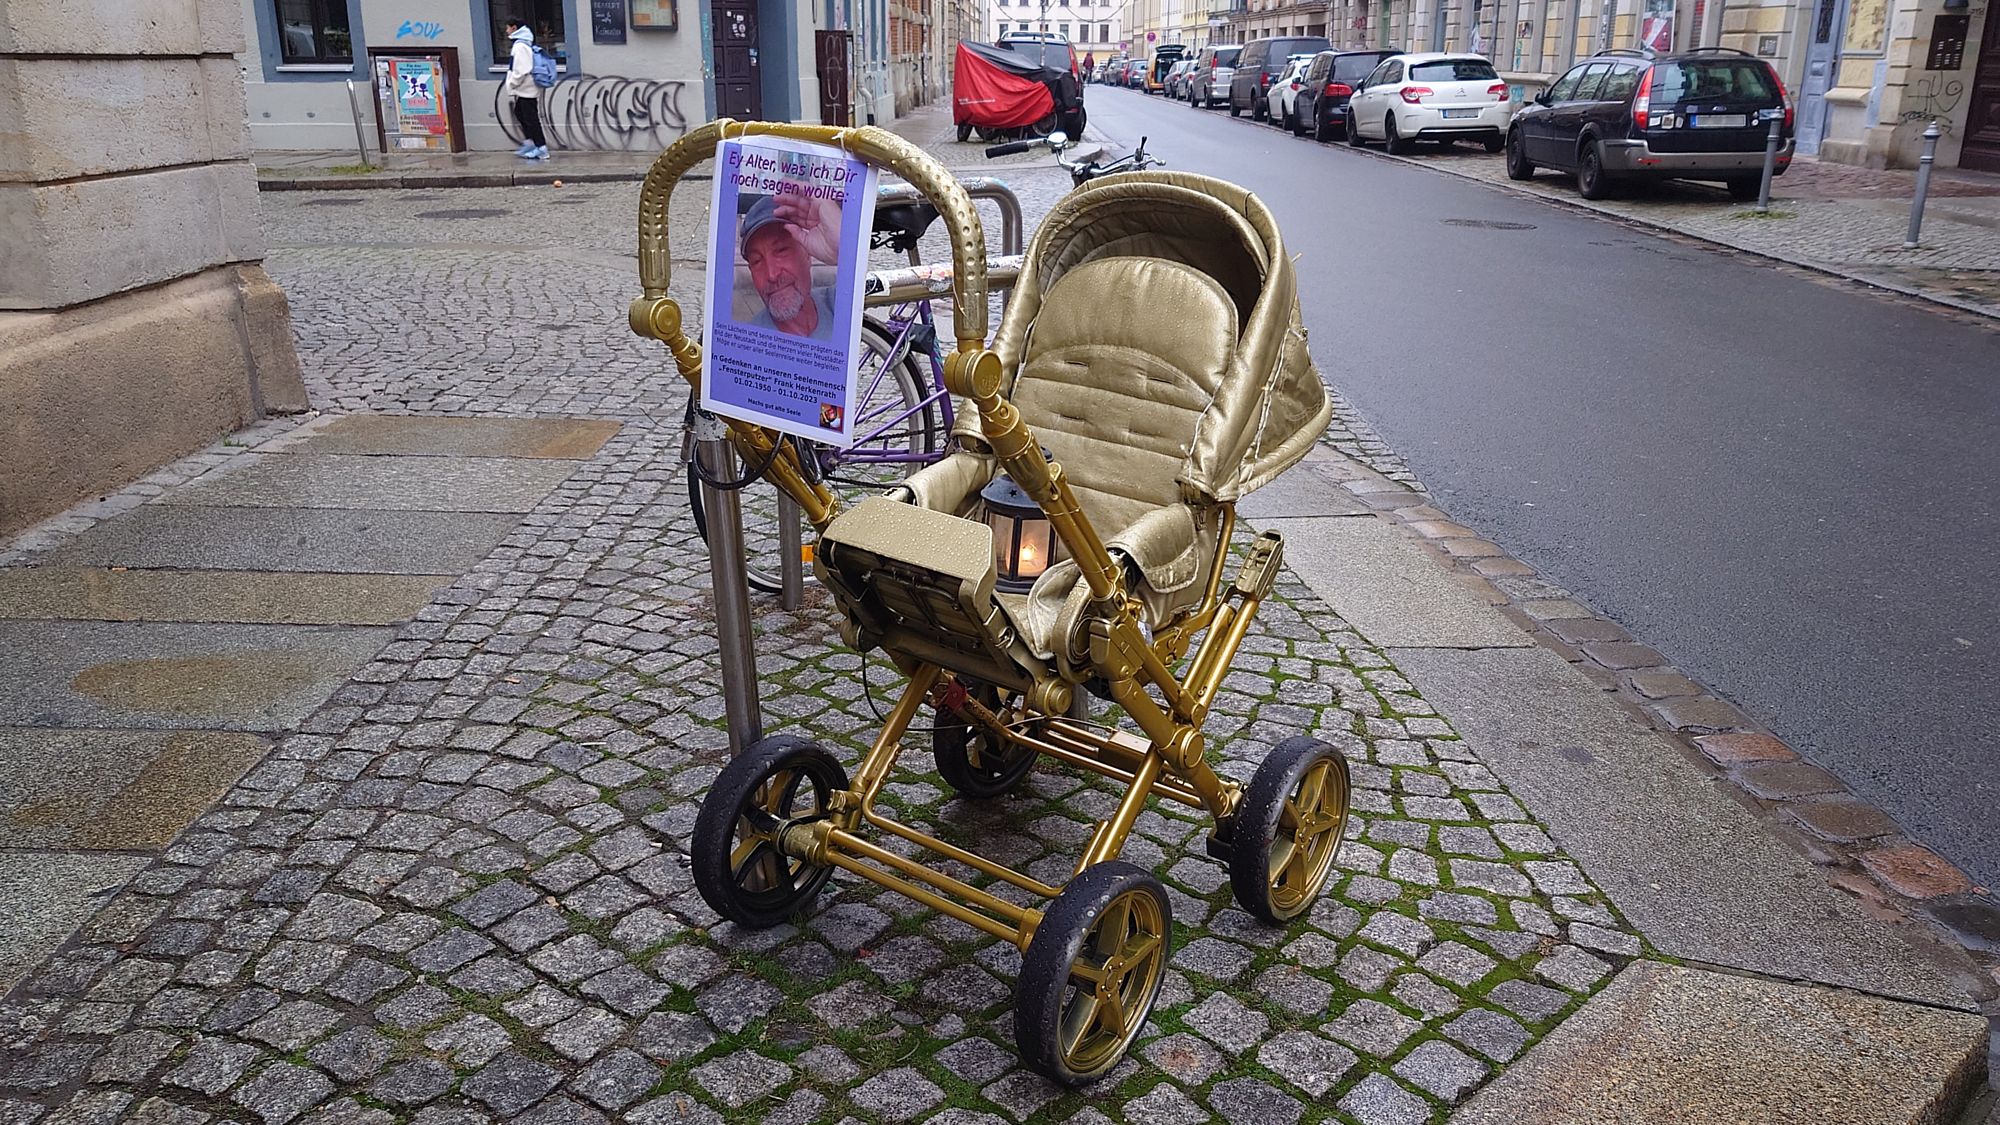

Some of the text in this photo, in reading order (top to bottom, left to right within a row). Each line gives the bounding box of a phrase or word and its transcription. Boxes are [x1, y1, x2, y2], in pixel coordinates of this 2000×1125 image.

[729, 152, 858, 183] Ey Alter, was ich Dir
[730, 172, 849, 203] noch sagen wollte:
[728, 324, 747, 334] Lächeln
[773, 335, 810, 349] Umarmungen
[810, 344, 832, 355] prägten
[734, 334, 756, 344] Neustadt
[778, 344, 796, 353] Herzen
[719, 355, 752, 369] Gedenken
[764, 368, 792, 379] unseren
[794, 373, 846, 392] Seelenmensch
[734, 377, 771, 392] 01.02.1950
[778, 388, 818, 404] 01.10.2023
[774, 378, 794, 389] Frank
[796, 383, 837, 399] Herkenrath
[748, 398, 764, 407] Machs
[787, 408, 801, 416] Seele
